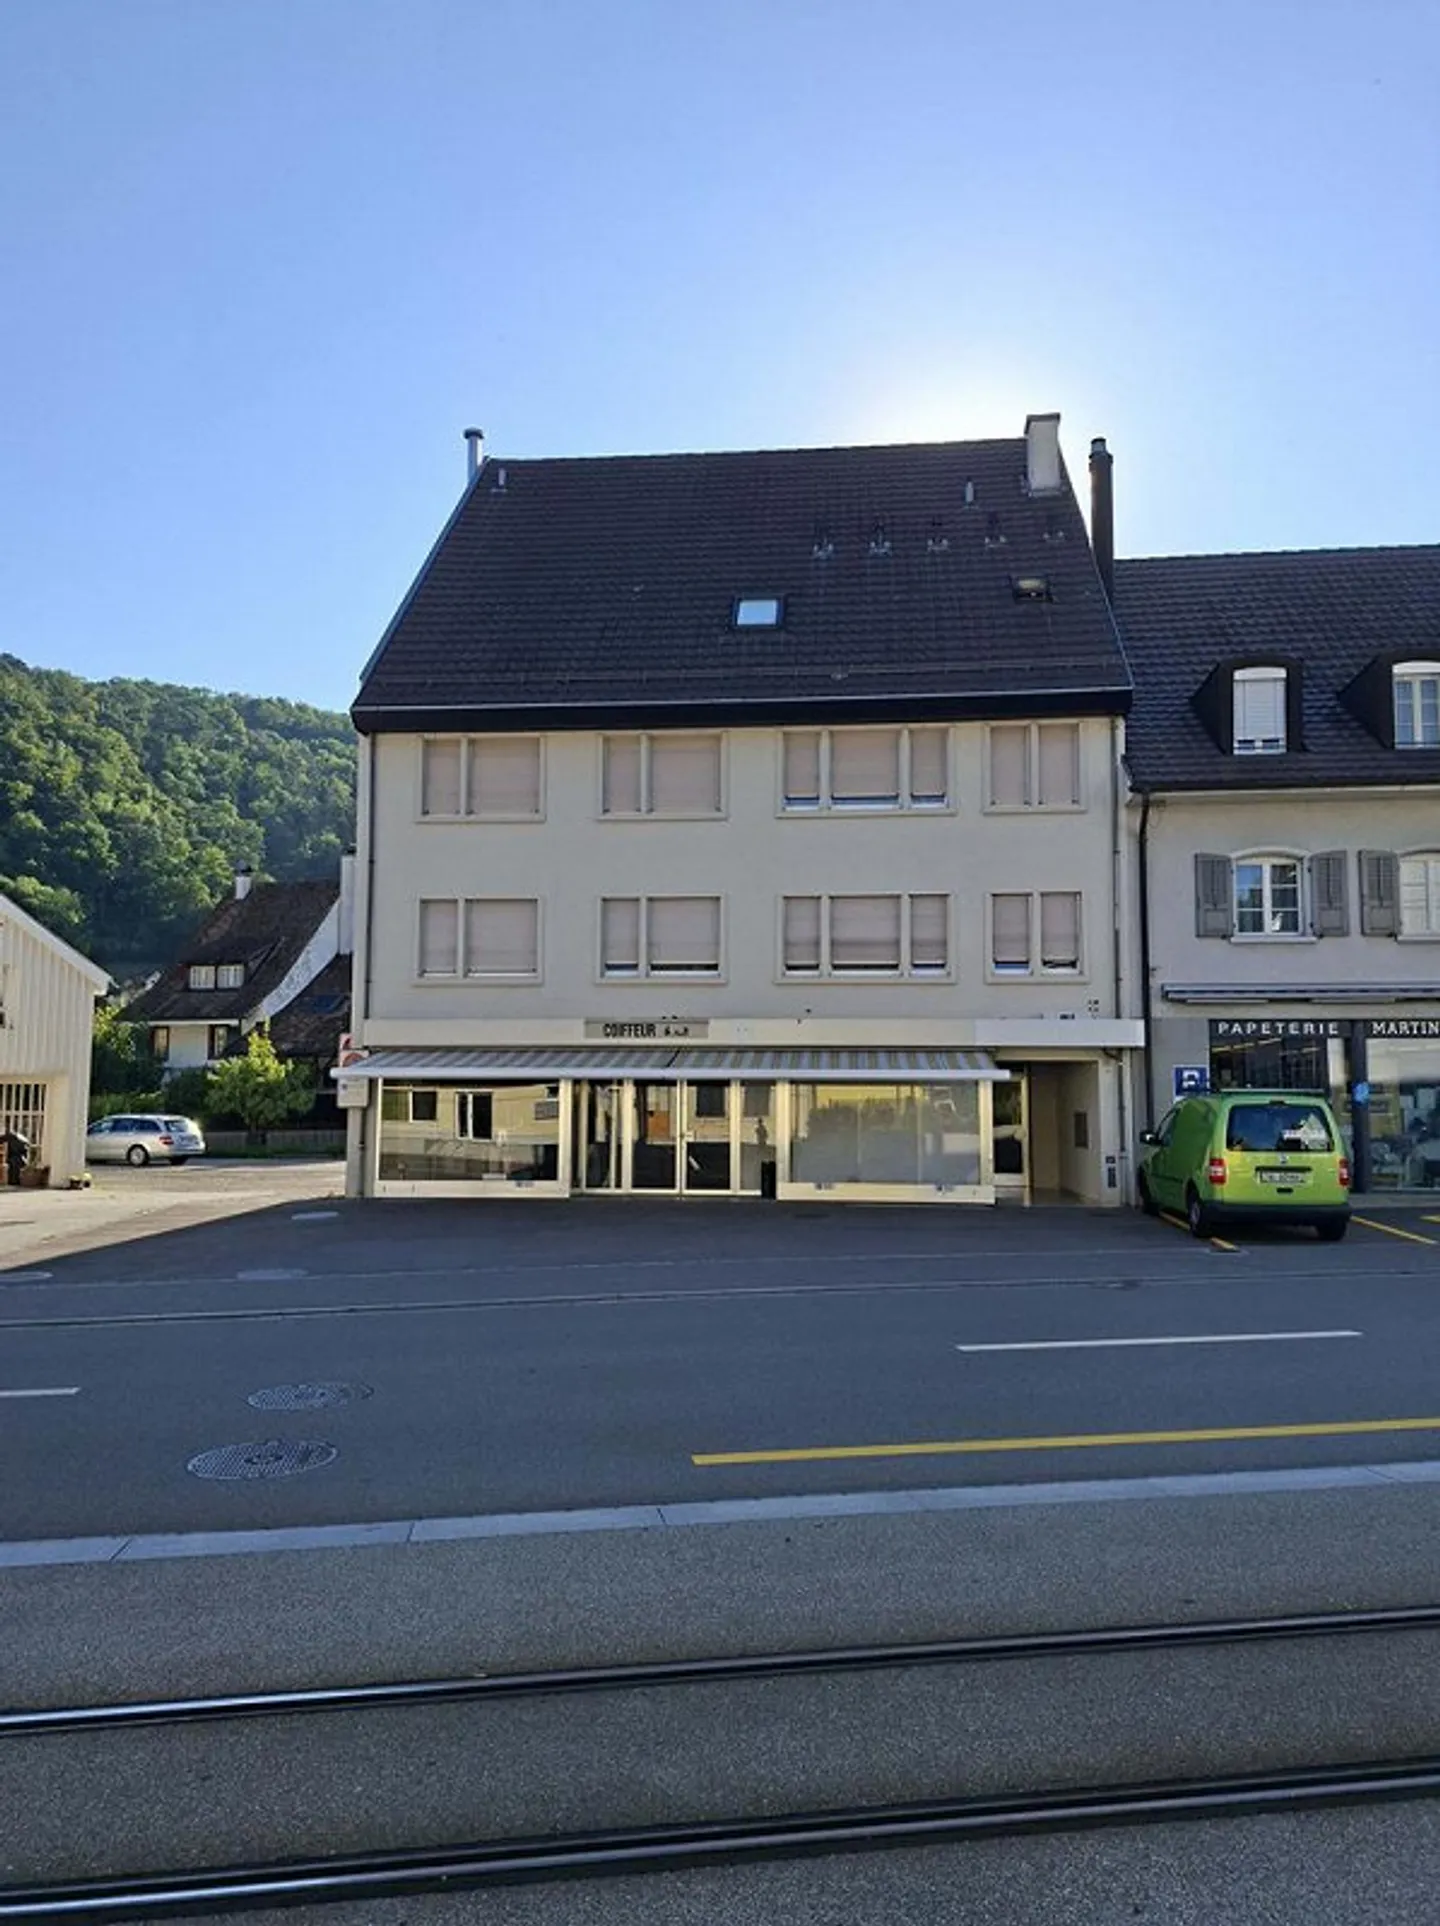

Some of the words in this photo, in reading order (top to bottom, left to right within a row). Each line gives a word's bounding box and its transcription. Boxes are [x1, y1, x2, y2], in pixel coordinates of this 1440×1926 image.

[602, 1022, 657, 1038] COIFFEUR
[1217, 1021, 1339, 1035] PAPETERIE
[1371, 1020, 1439, 1035] MARTIN
